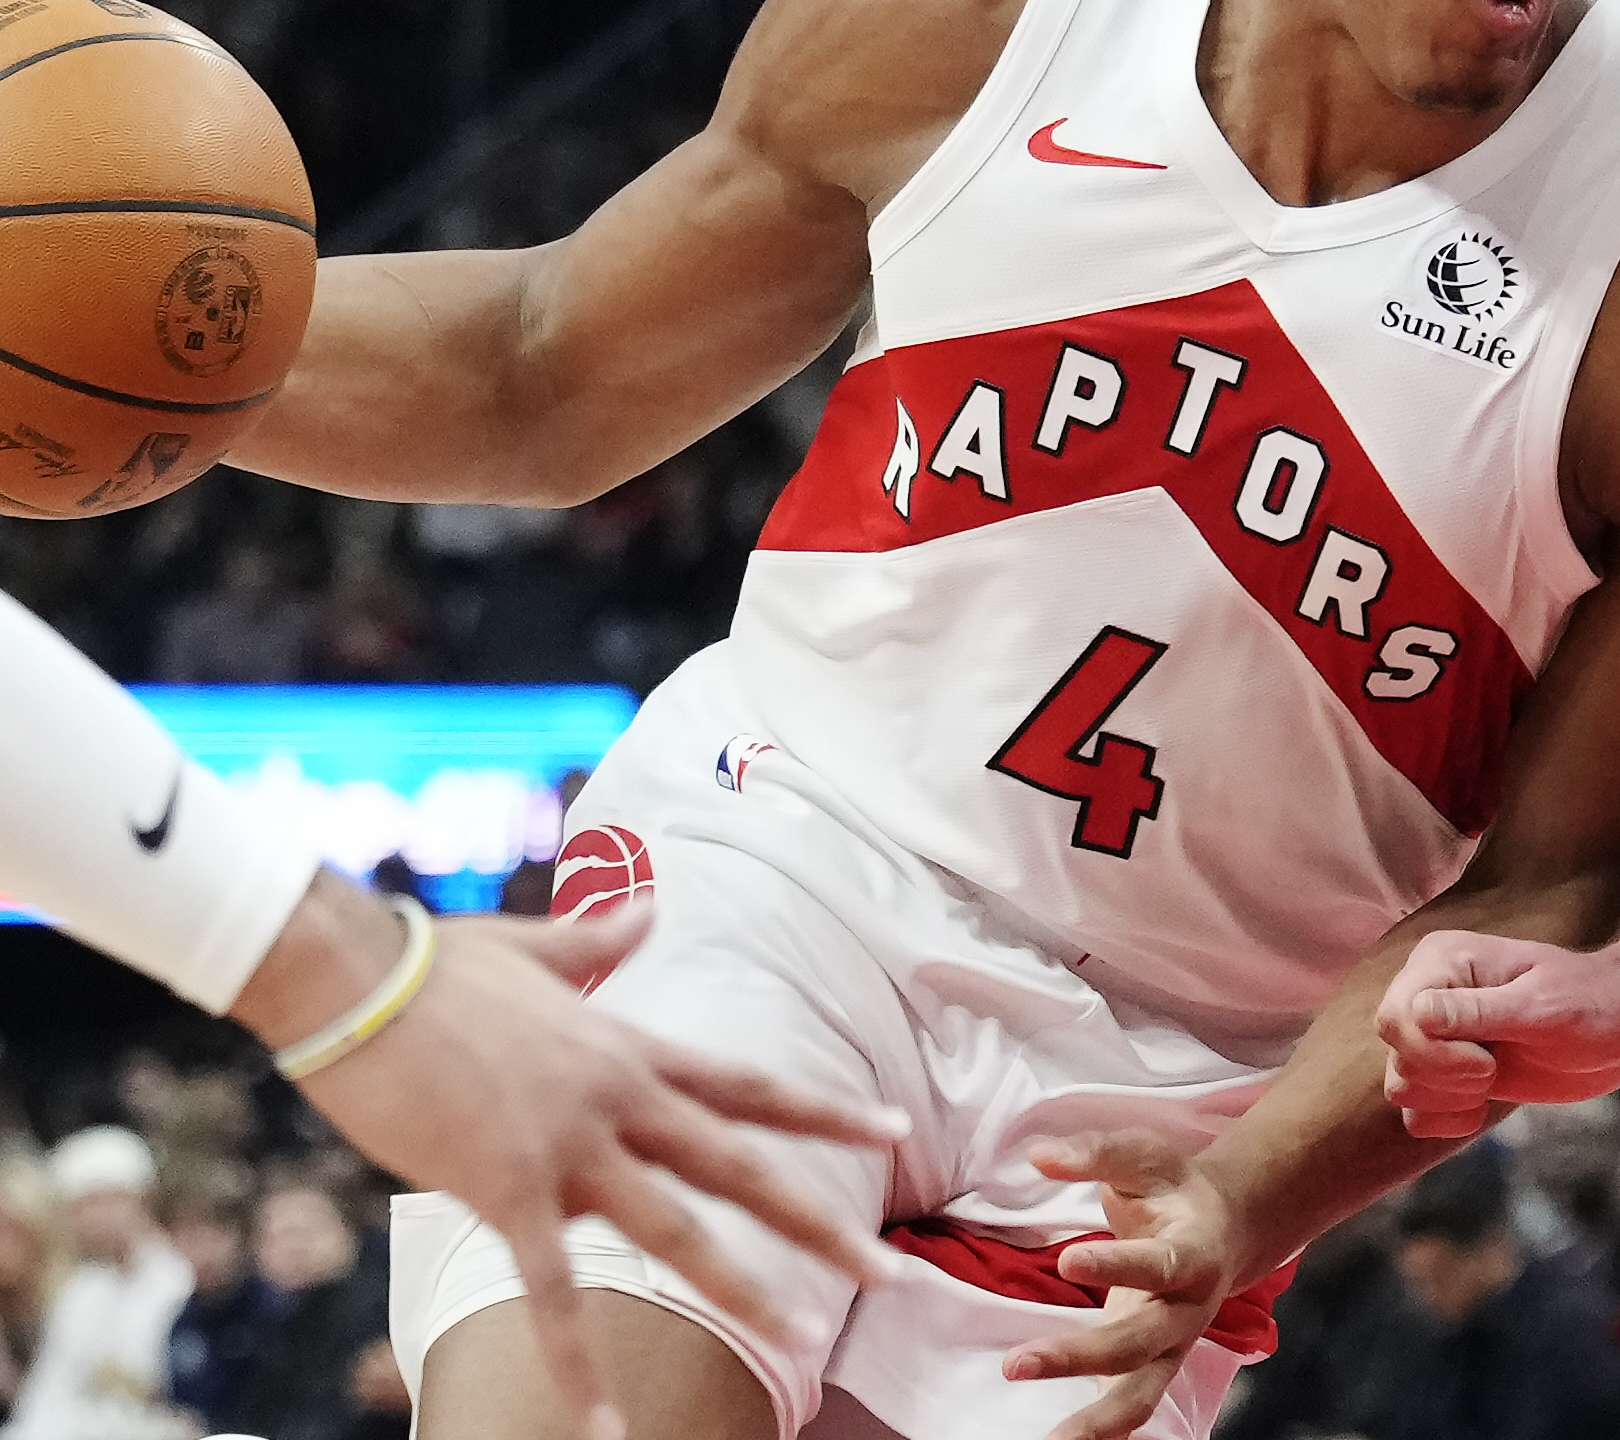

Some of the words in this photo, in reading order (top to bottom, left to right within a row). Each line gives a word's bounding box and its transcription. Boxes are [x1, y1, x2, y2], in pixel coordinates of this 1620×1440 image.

[1381, 301, 1446, 345] Sun
[1452, 324, 1516, 369] Life
[883, 337, 1457, 700] RAPTORS
[986, 624, 1168, 860] 4
